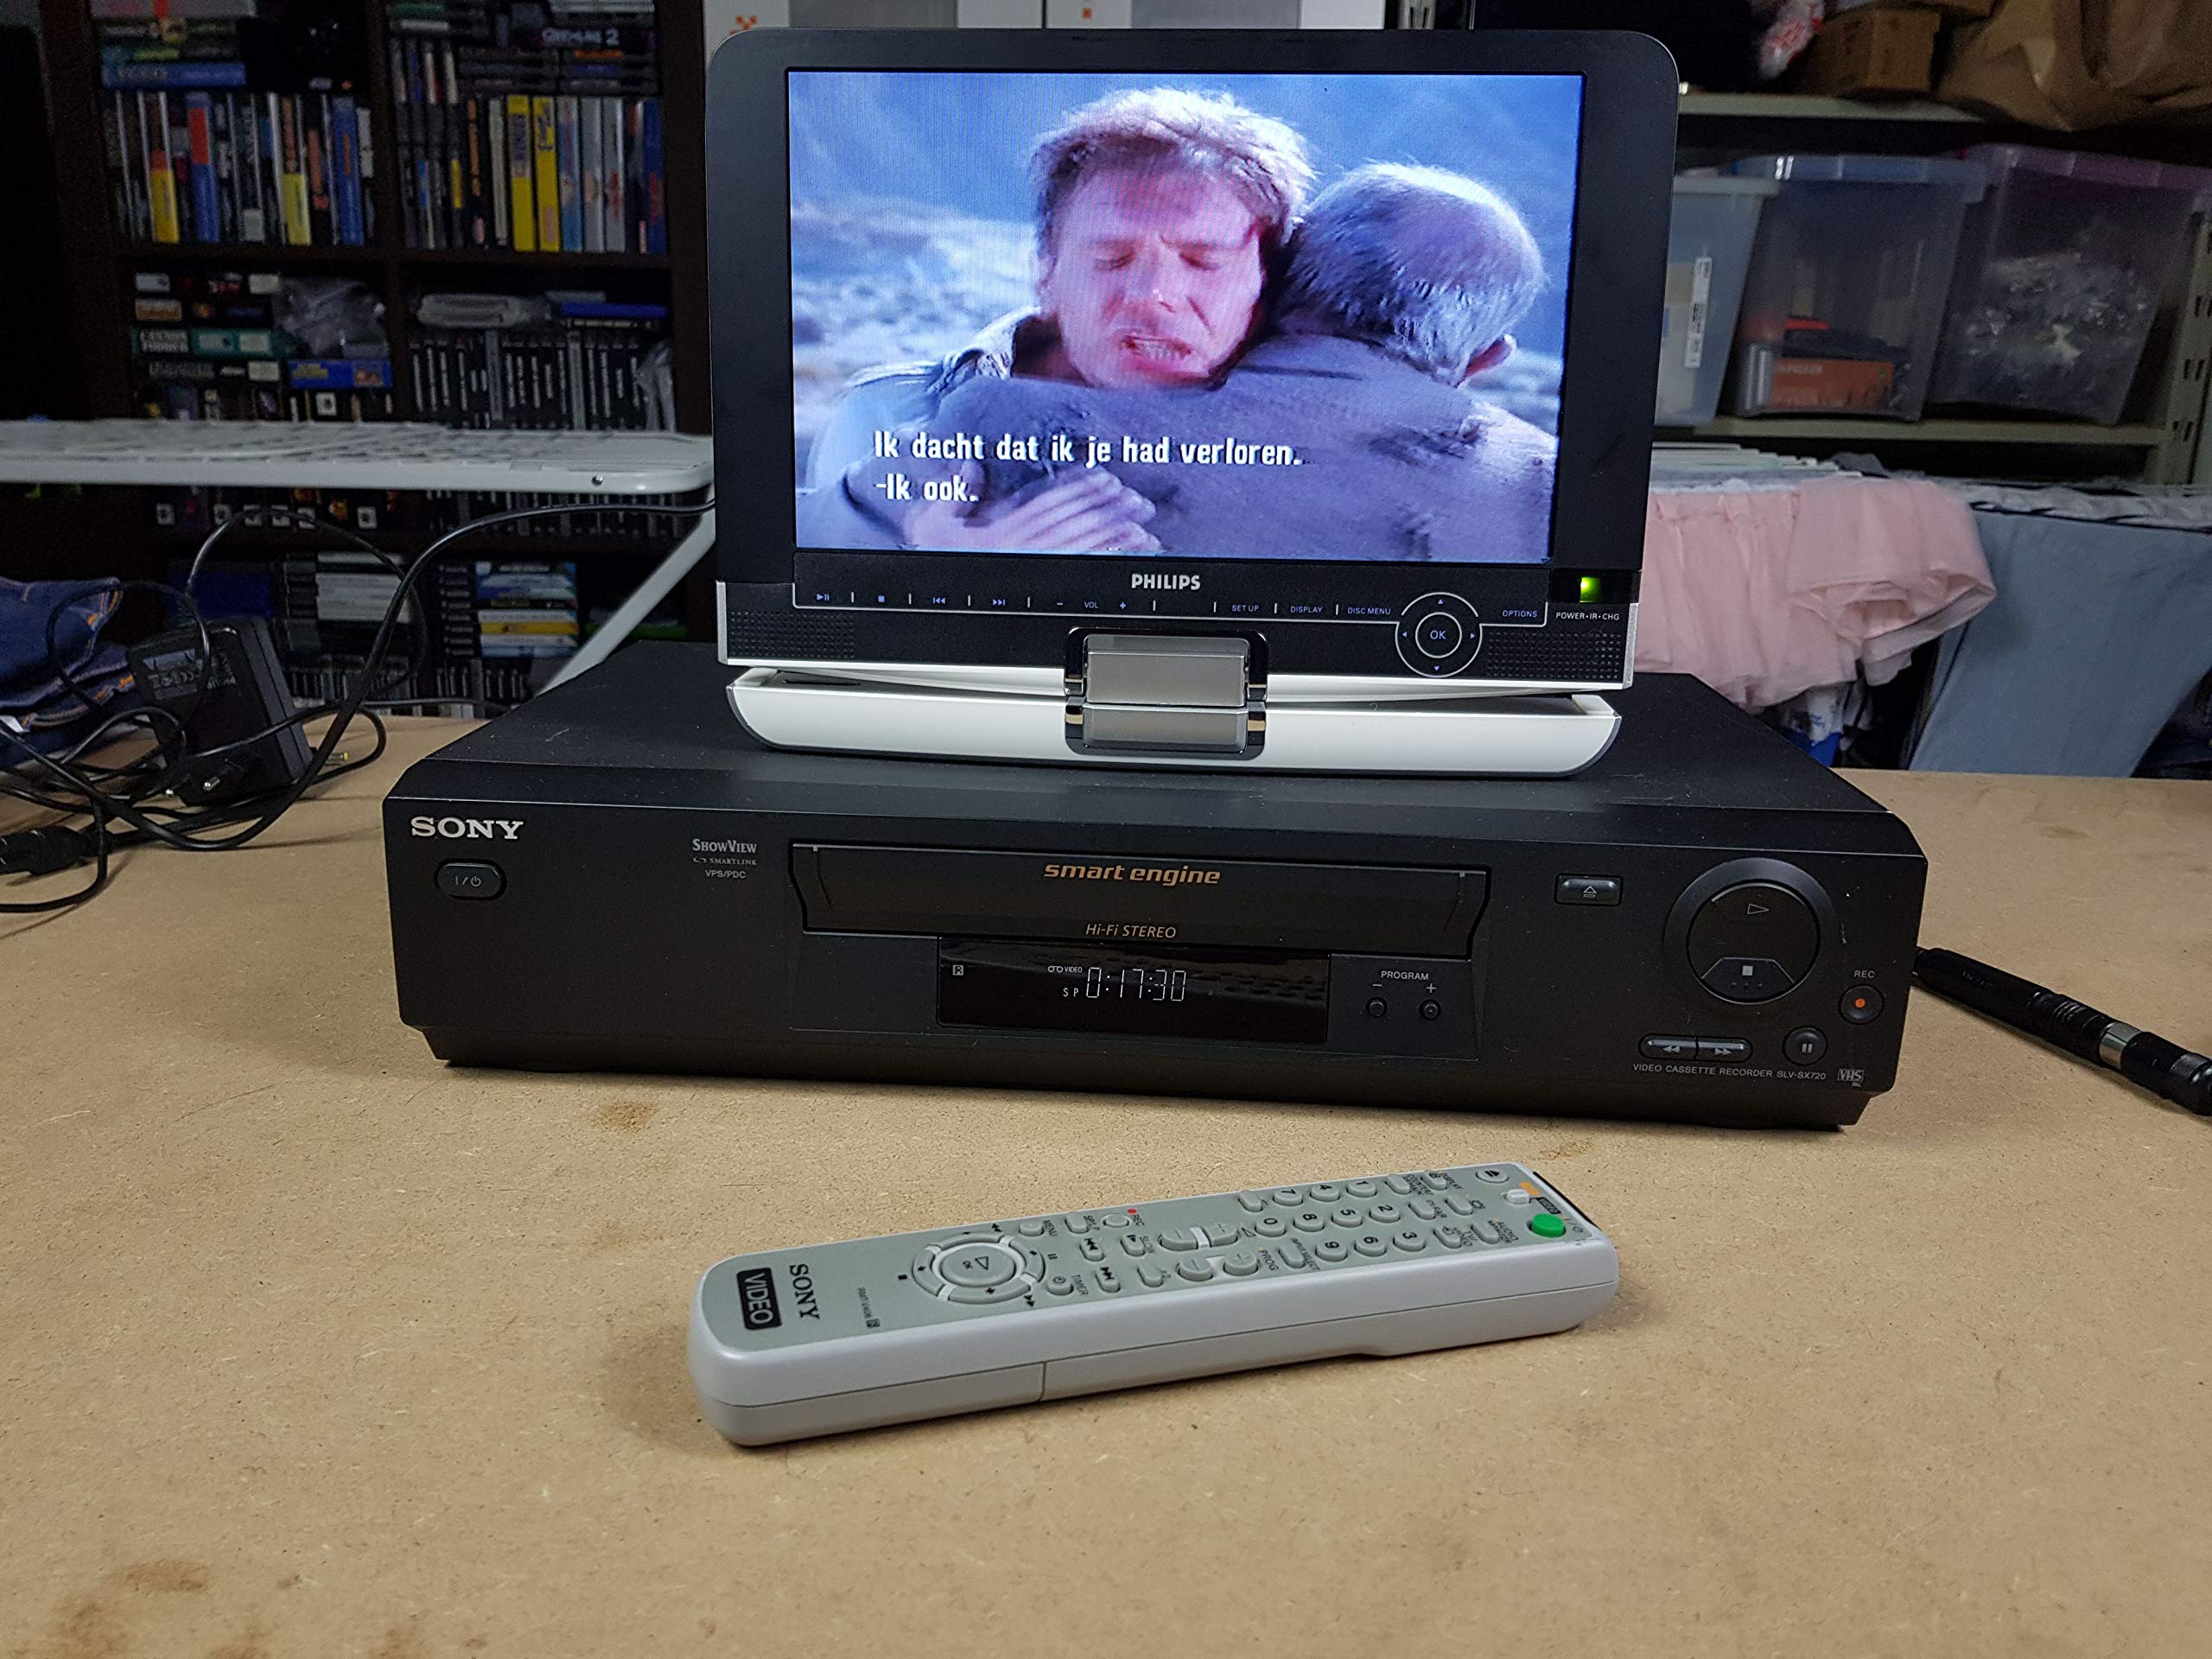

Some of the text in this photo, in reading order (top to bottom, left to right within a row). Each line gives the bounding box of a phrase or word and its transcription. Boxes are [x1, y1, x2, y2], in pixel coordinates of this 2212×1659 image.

[874, 430, 1303, 468] Ik dacht dat ik je had verloren.
[875, 473, 979, 502] -Ik ook.
[1131, 574, 1201, 591] PHILIPS
[1502, 610, 1538, 619] OPTIONS
[1430, 630, 1446, 640] OK
[410, 817, 524, 840] SONY
[709, 857, 758, 866] SMARTLINK
[705, 869, 747, 879] VPS/PDC
[1044, 864, 1221, 887] smart engine
[1085, 924, 1177, 939] Hi-Fi STEREO
[1381, 970, 1429, 981] PROGRAM
[1853, 970, 1875, 979] REC
[1086, 967, 1186, 1001] 0:17:30
[1632, 1063, 1827, 1080] VIDEO CASSETTE RECORDER SLV-SX720
[1839, 1068, 1864, 1082] VHS
[1258, 1249, 1279, 1271] PROG
[743, 1272, 774, 1325] VIDEO
[790, 1262, 820, 1320] SONY
